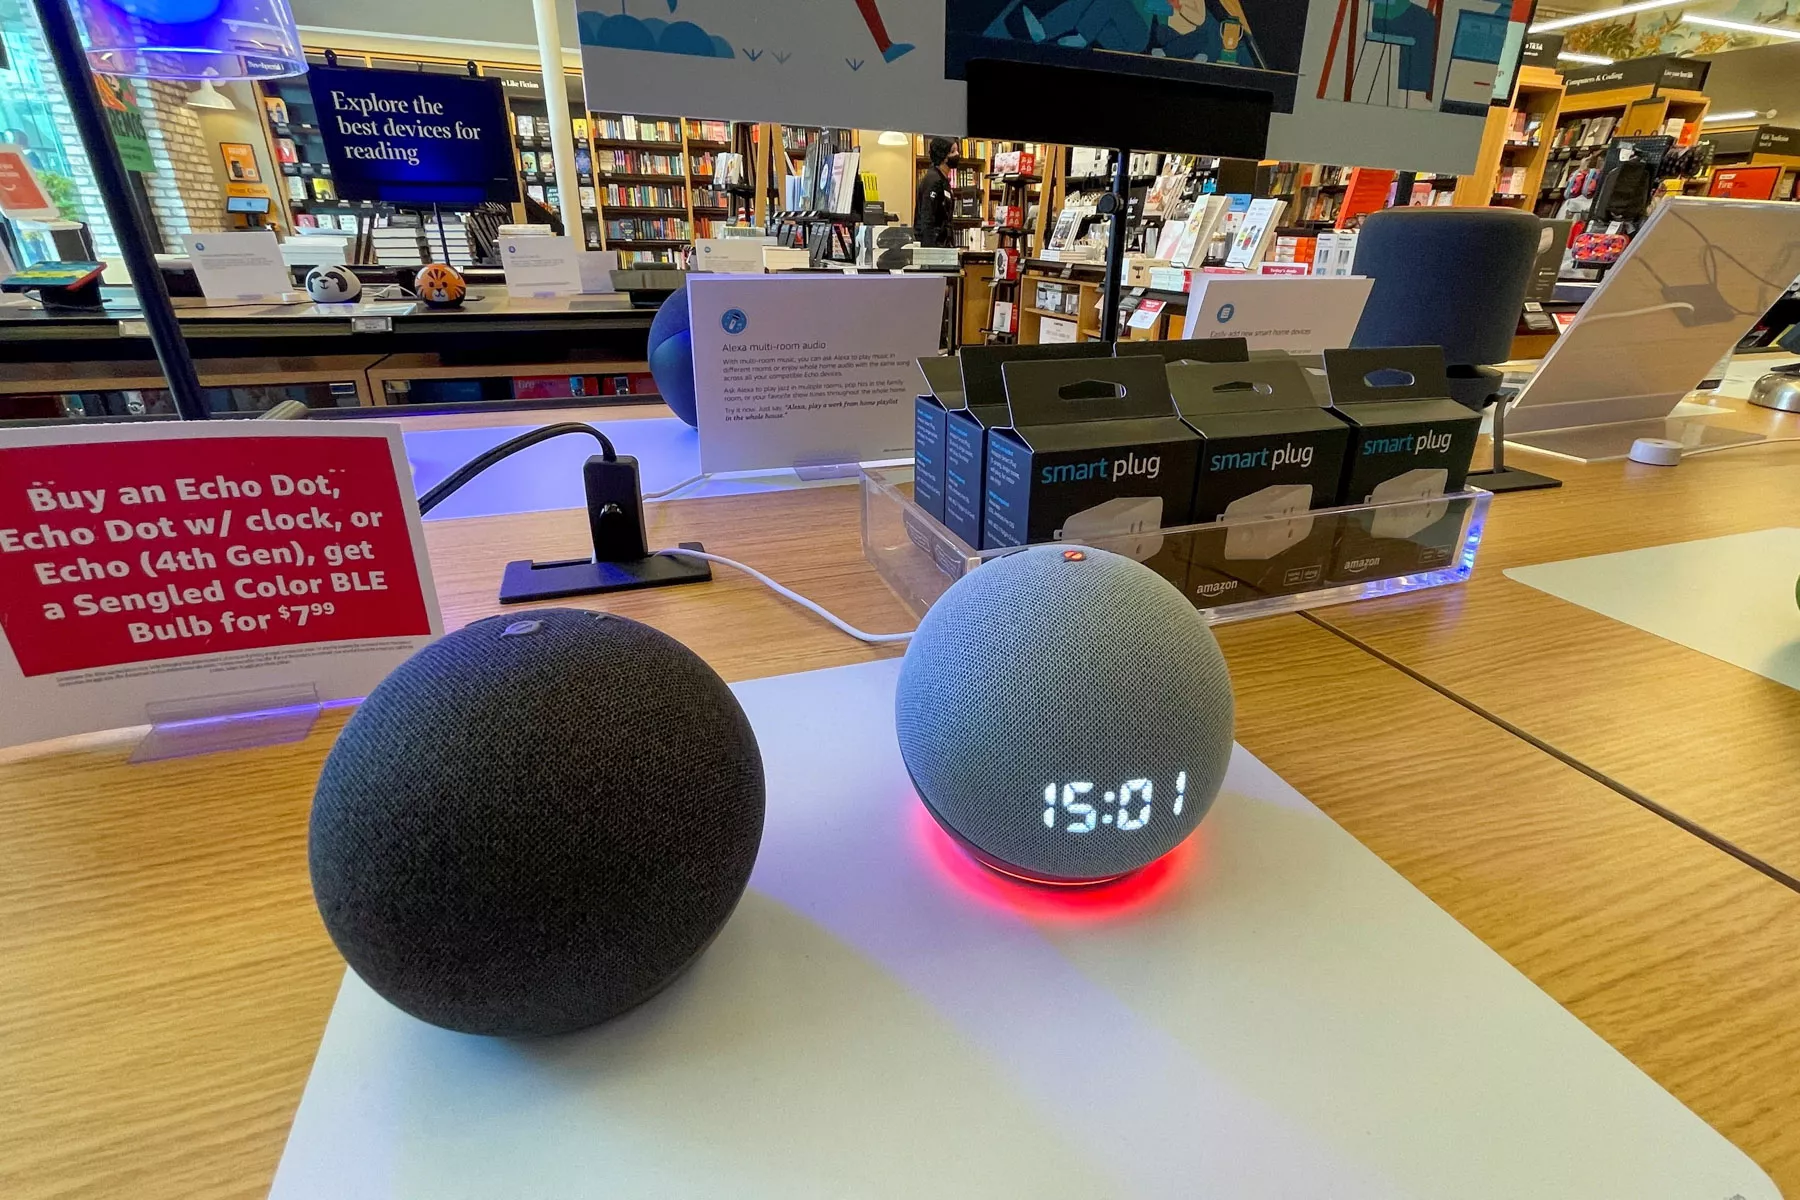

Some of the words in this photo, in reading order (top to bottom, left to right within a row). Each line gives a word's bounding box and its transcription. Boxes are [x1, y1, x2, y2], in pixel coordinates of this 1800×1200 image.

[1602, 72, 1623, 82] Coding
[330, 90, 408, 117] Explore
[414, 95, 444, 115] the
[336, 116, 380, 136] best
[384, 118, 451, 138] devices
[455, 121, 480, 140] for
[344, 142, 420, 166] reading
[722, 343, 747, 352] Alexa
[750, 342, 800, 351] multi-room
[802, 340, 826, 350] audio
[1210, 447, 1270, 472] smart
[1271, 442, 1314, 470] plug
[1362, 433, 1413, 456] smart
[1414, 430, 1452, 454] plug
[1041, 457, 1108, 484] smart
[1112, 452, 1161, 482] plug
[27, 486, 106, 514] Buy
[120, 483, 166, 505] an
[175, 475, 262, 501] Echo
[270, 474, 340, 500] Dot,
[0, 522, 94, 552] Echo
[104, 517, 176, 543] Dot
[184, 510, 232, 538] w/
[246, 506, 342, 534] clock,
[350, 508, 383, 528] or
[34, 556, 130, 586] Echo
[140, 548, 216, 578] (4th
[227, 540, 316, 568] Gen),
[324, 539, 375, 566] get
[1344, 556, 1381, 571] amazon
[42, 601, 66, 620] a
[73, 580, 226, 618] Sengled
[234, 574, 322, 600] Color
[331, 570, 388, 594] BLE
[1196, 579, 1238, 596] amazon
[128, 614, 212, 644] Bulb
[220, 608, 272, 633] for
[1043, 771, 1186, 833] 15:01
